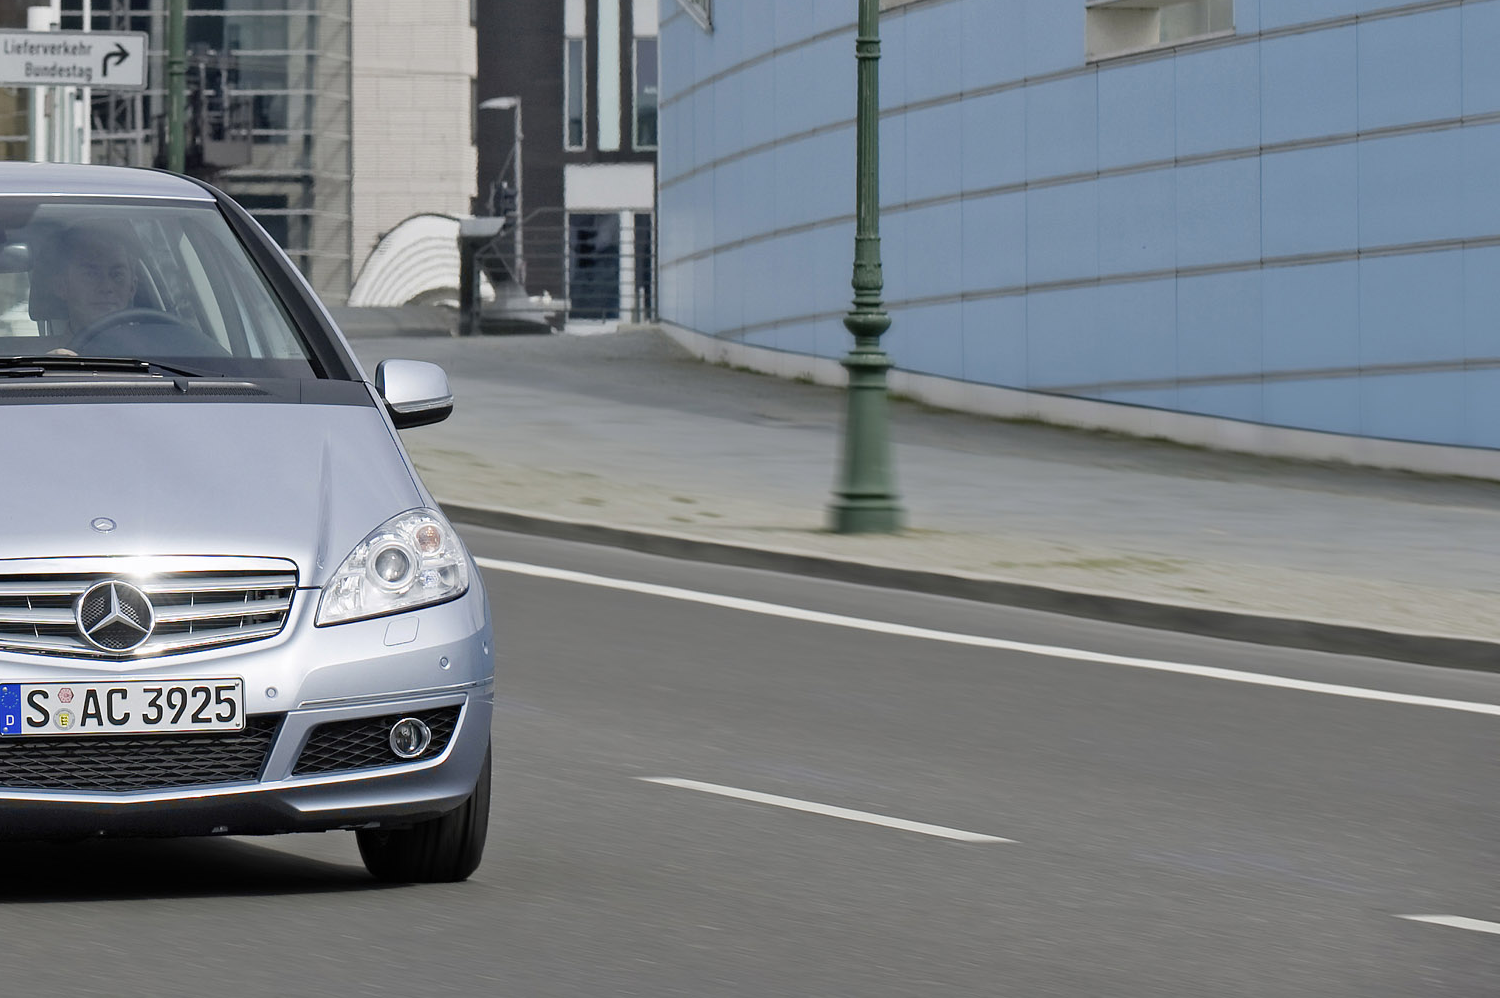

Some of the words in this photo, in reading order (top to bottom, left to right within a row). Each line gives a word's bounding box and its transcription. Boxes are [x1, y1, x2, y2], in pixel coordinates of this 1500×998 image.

[4, 39, 93, 56] Lieferverkehr
[25, 62, 93, 82] Bundestag
[5, 715, 15, 726] D
[26, 689, 50, 728] S
[80, 687, 131, 727] AC
[142, 685, 237, 725] 3925
